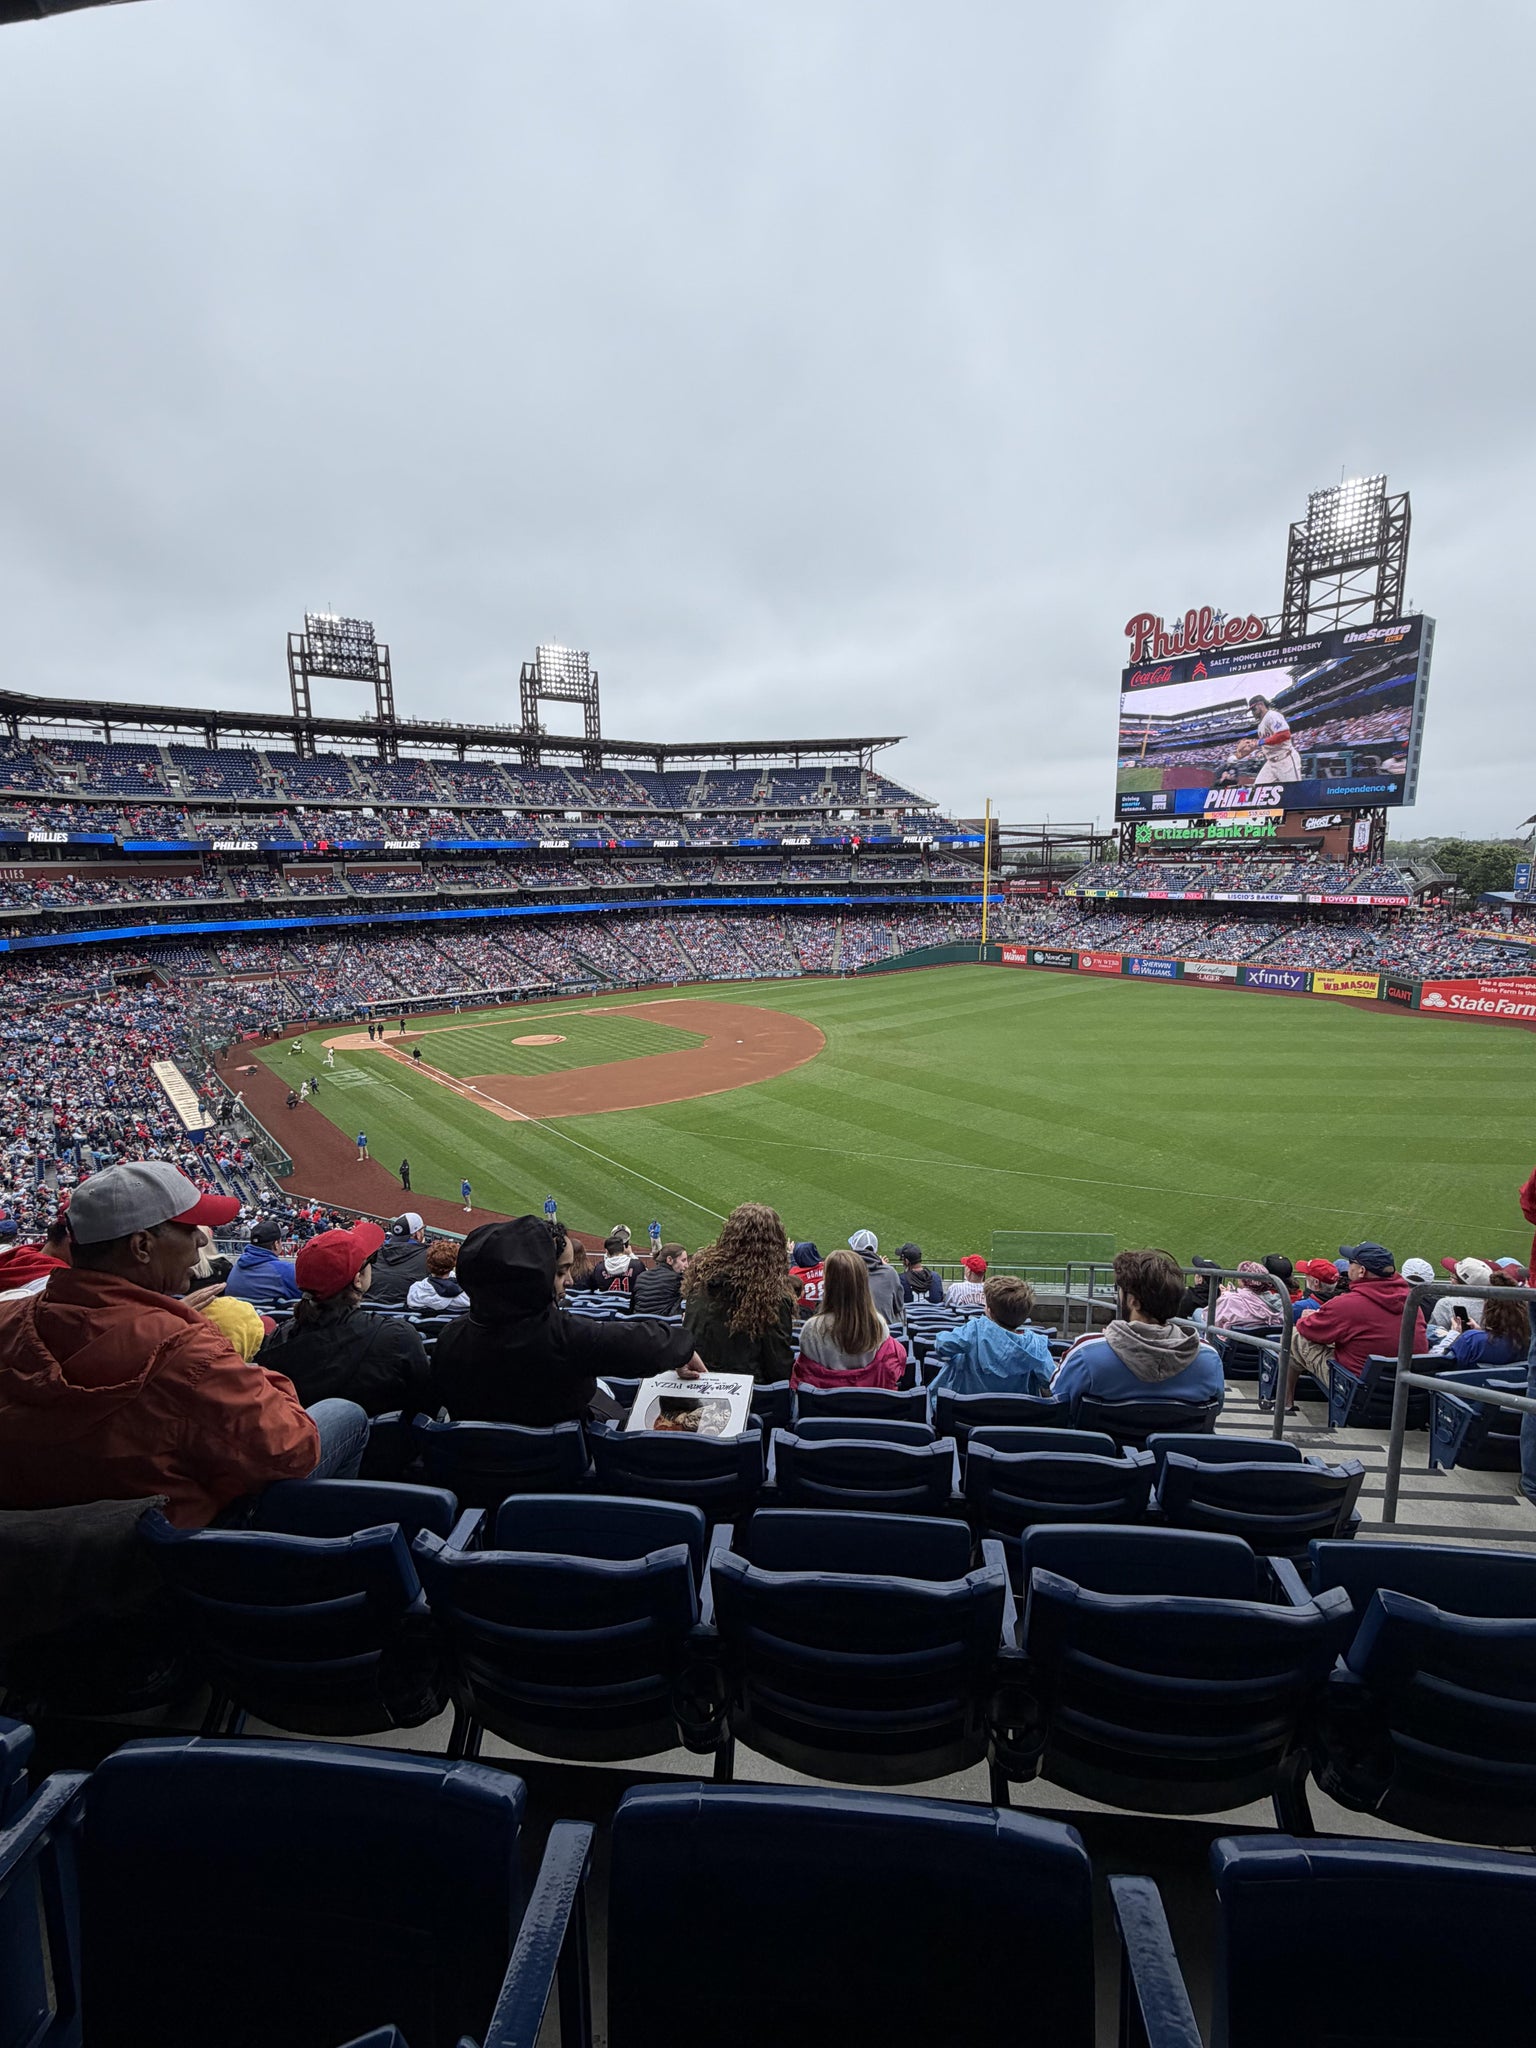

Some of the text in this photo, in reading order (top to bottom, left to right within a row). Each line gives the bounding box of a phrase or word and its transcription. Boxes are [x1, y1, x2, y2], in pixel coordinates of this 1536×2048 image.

[1125, 606, 1265, 663] Phillies
[1343, 624, 1412, 644] theScore
[1210, 658, 1230, 666] SALTZ
[1282, 642, 1322, 654] BENDESKY
[1230, 656, 1298, 672] INJURY LAWYERS
[1327, 785, 1385, 795] Independence
[1204, 786, 1283, 808] PHILLIES
[1154, 822, 1278, 840] Citizens Bank Park
[28, 832, 68, 842] PHILLIES
[782, 838, 811, 846] PHILLIES
[213, 842, 258, 850] PHILLIES
[384, 841, 420, 849] PHILLIES
[539, 840, 569, 848] PHILLIES
[653, 840, 679, 848] PHILLIES
[1004, 952, 1026, 961] Wawa
[1045, 953, 1071, 961] NovaCare
[1142, 960, 1171, 969] SHERWIN
[1249, 969, 1300, 987] xfinity
[1388, 987, 1412, 1001] GIANT
[1448, 995, 1495, 1012] State
[608, 1277, 629, 1292] 41
[655, 1381, 682, 1389] PIZZA
